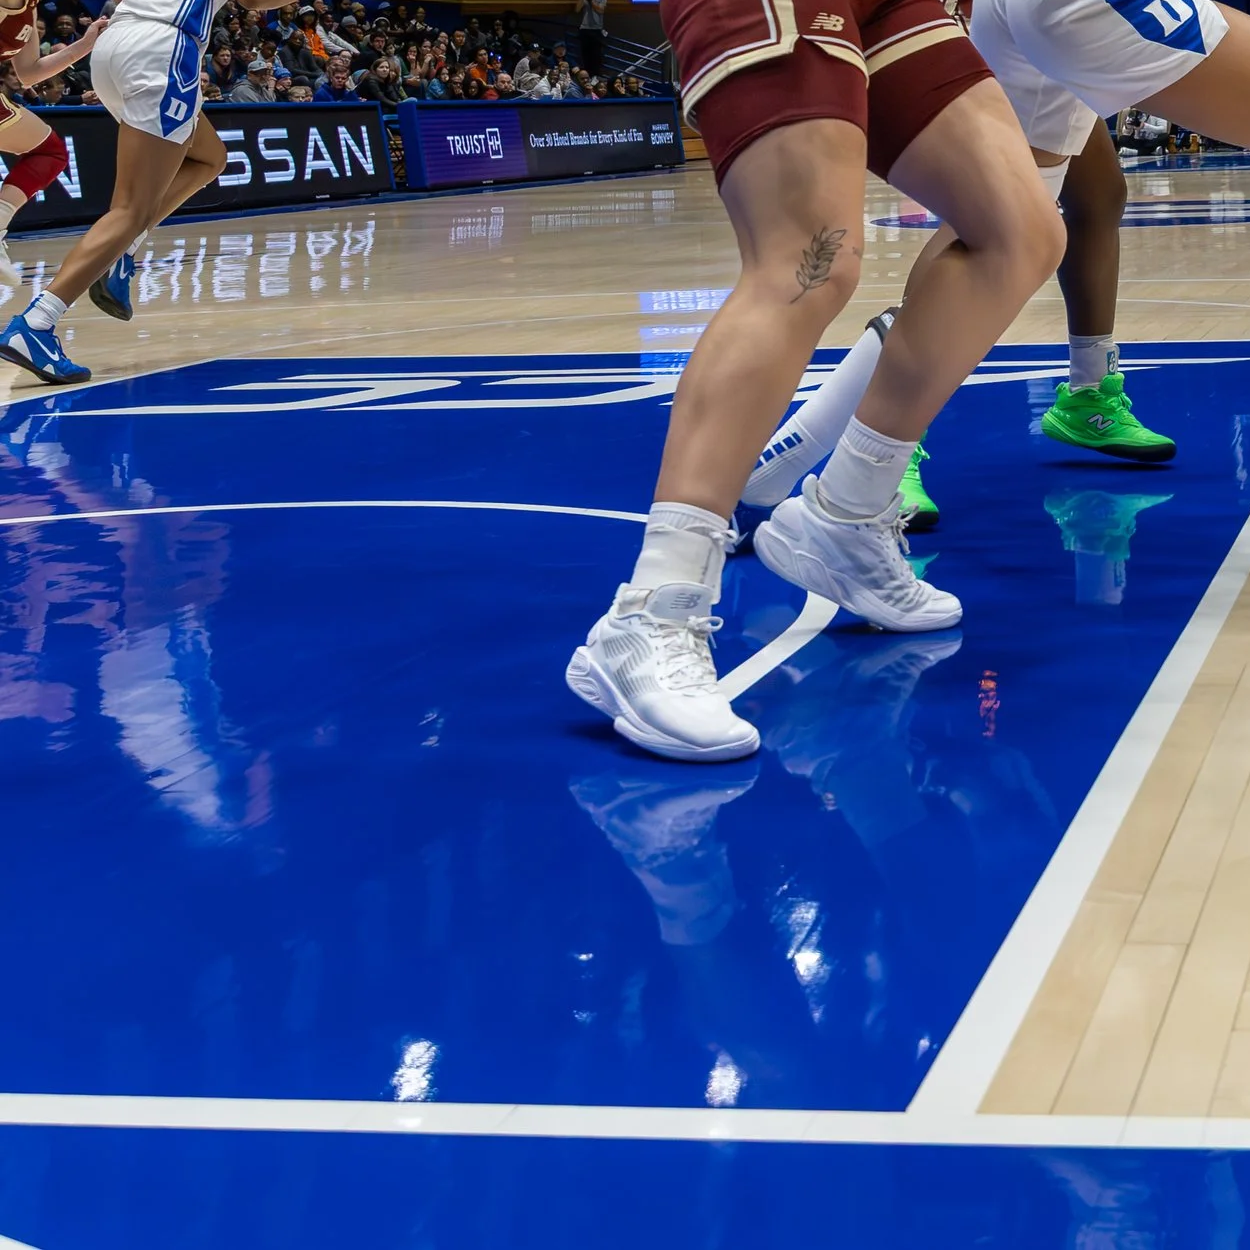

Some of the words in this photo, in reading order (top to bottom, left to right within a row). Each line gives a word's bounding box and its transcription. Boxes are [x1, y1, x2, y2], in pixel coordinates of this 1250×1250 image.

[446, 133, 487, 156] TRUIST
[529, 133, 546, 148] Over
[553, 132, 571, 147] Hotel
[571, 131, 590, 146] Brands
[589, 130, 598, 145] for
[598, 130, 613, 147] Every
[613, 129, 628, 143] Kind
[627, 129, 634, 142] of
[634, 128, 644, 142] Fan
[218, 125, 376, 187] SSAN
